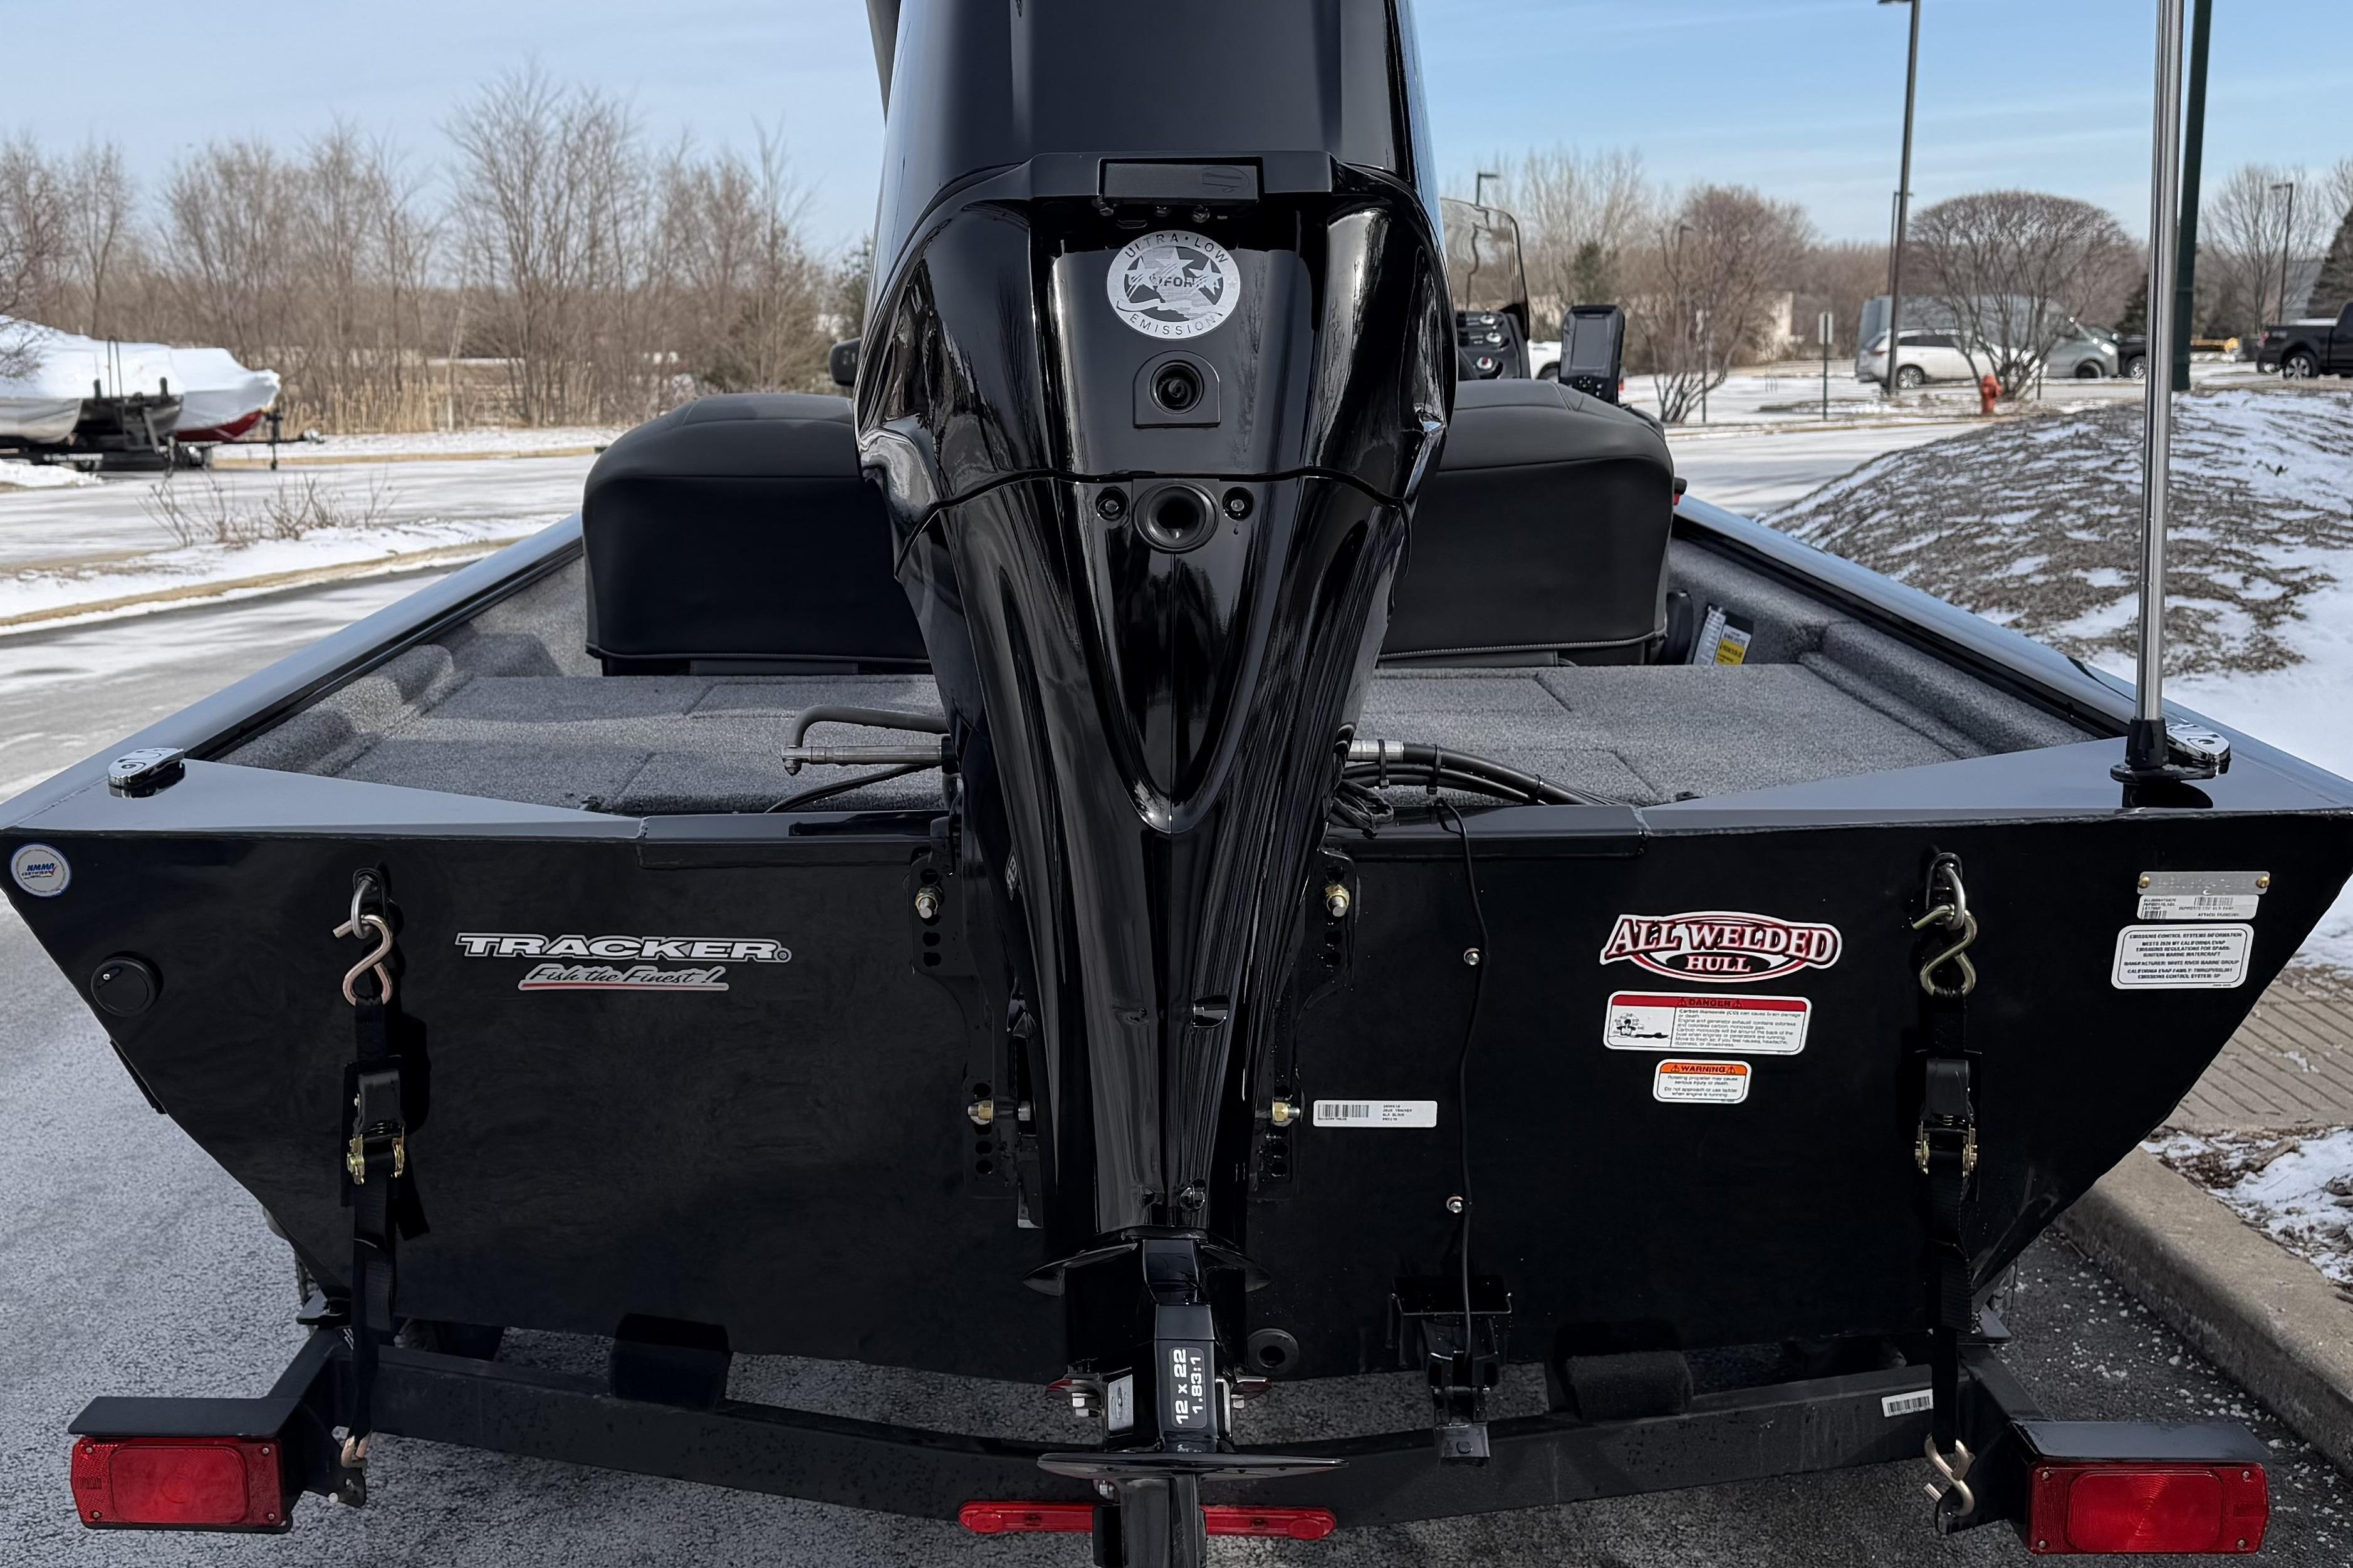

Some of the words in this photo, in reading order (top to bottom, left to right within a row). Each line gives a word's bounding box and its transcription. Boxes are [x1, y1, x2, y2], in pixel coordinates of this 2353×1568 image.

[1194, 237, 1229, 264] LOW
[1130, 313, 1216, 335] EMISSION
[456, 933, 781, 962] TRACKER
[1605, 919, 1680, 959] ALL
[1686, 923, 1834, 963] WELDED
[530, 969, 580, 981] Fish
[583, 969, 620, 982] the
[1685, 955, 1751, 972] HULL
[1689, 999, 1731, 1007] DANGER
[1173, 1349, 1187, 1378] 22
[1190, 1356, 1203, 1415] 1.83:1
[1174, 1399, 1189, 1425] 12
